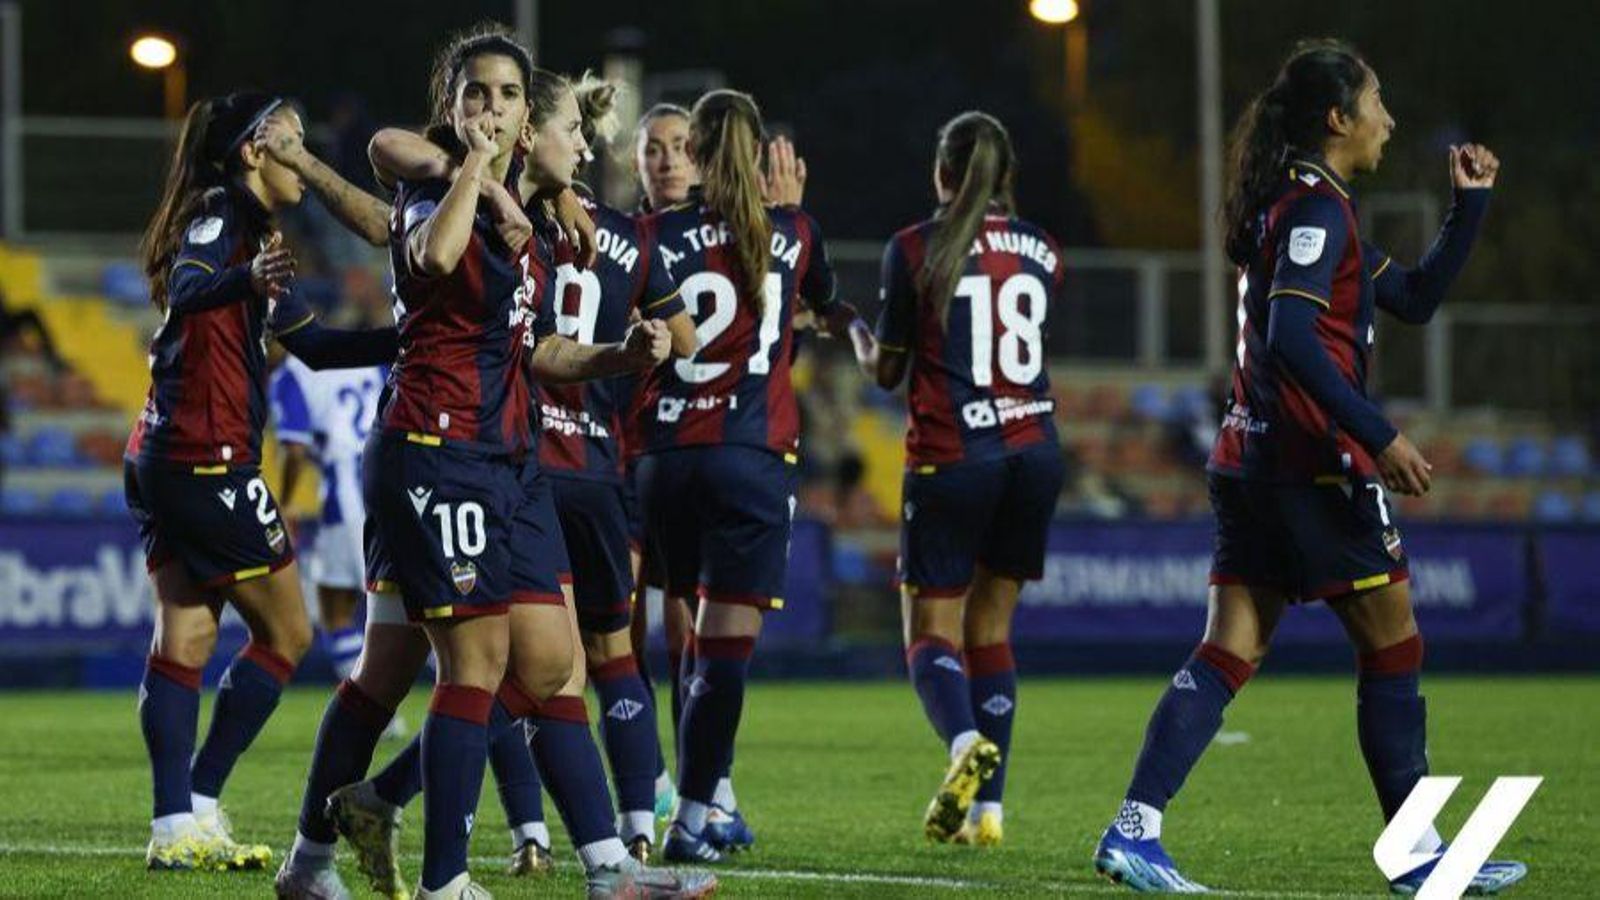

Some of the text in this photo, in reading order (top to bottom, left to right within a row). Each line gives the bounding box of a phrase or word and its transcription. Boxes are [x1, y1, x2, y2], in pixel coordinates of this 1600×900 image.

[658, 244, 686, 270] A.
[552, 262, 603, 346] 9
[674, 271, 784, 384] 21
[954, 273, 1048, 387] 18
[246, 477, 277, 526] 2
[432, 501, 487, 558] 10
[1365, 482, 1391, 526] 7
